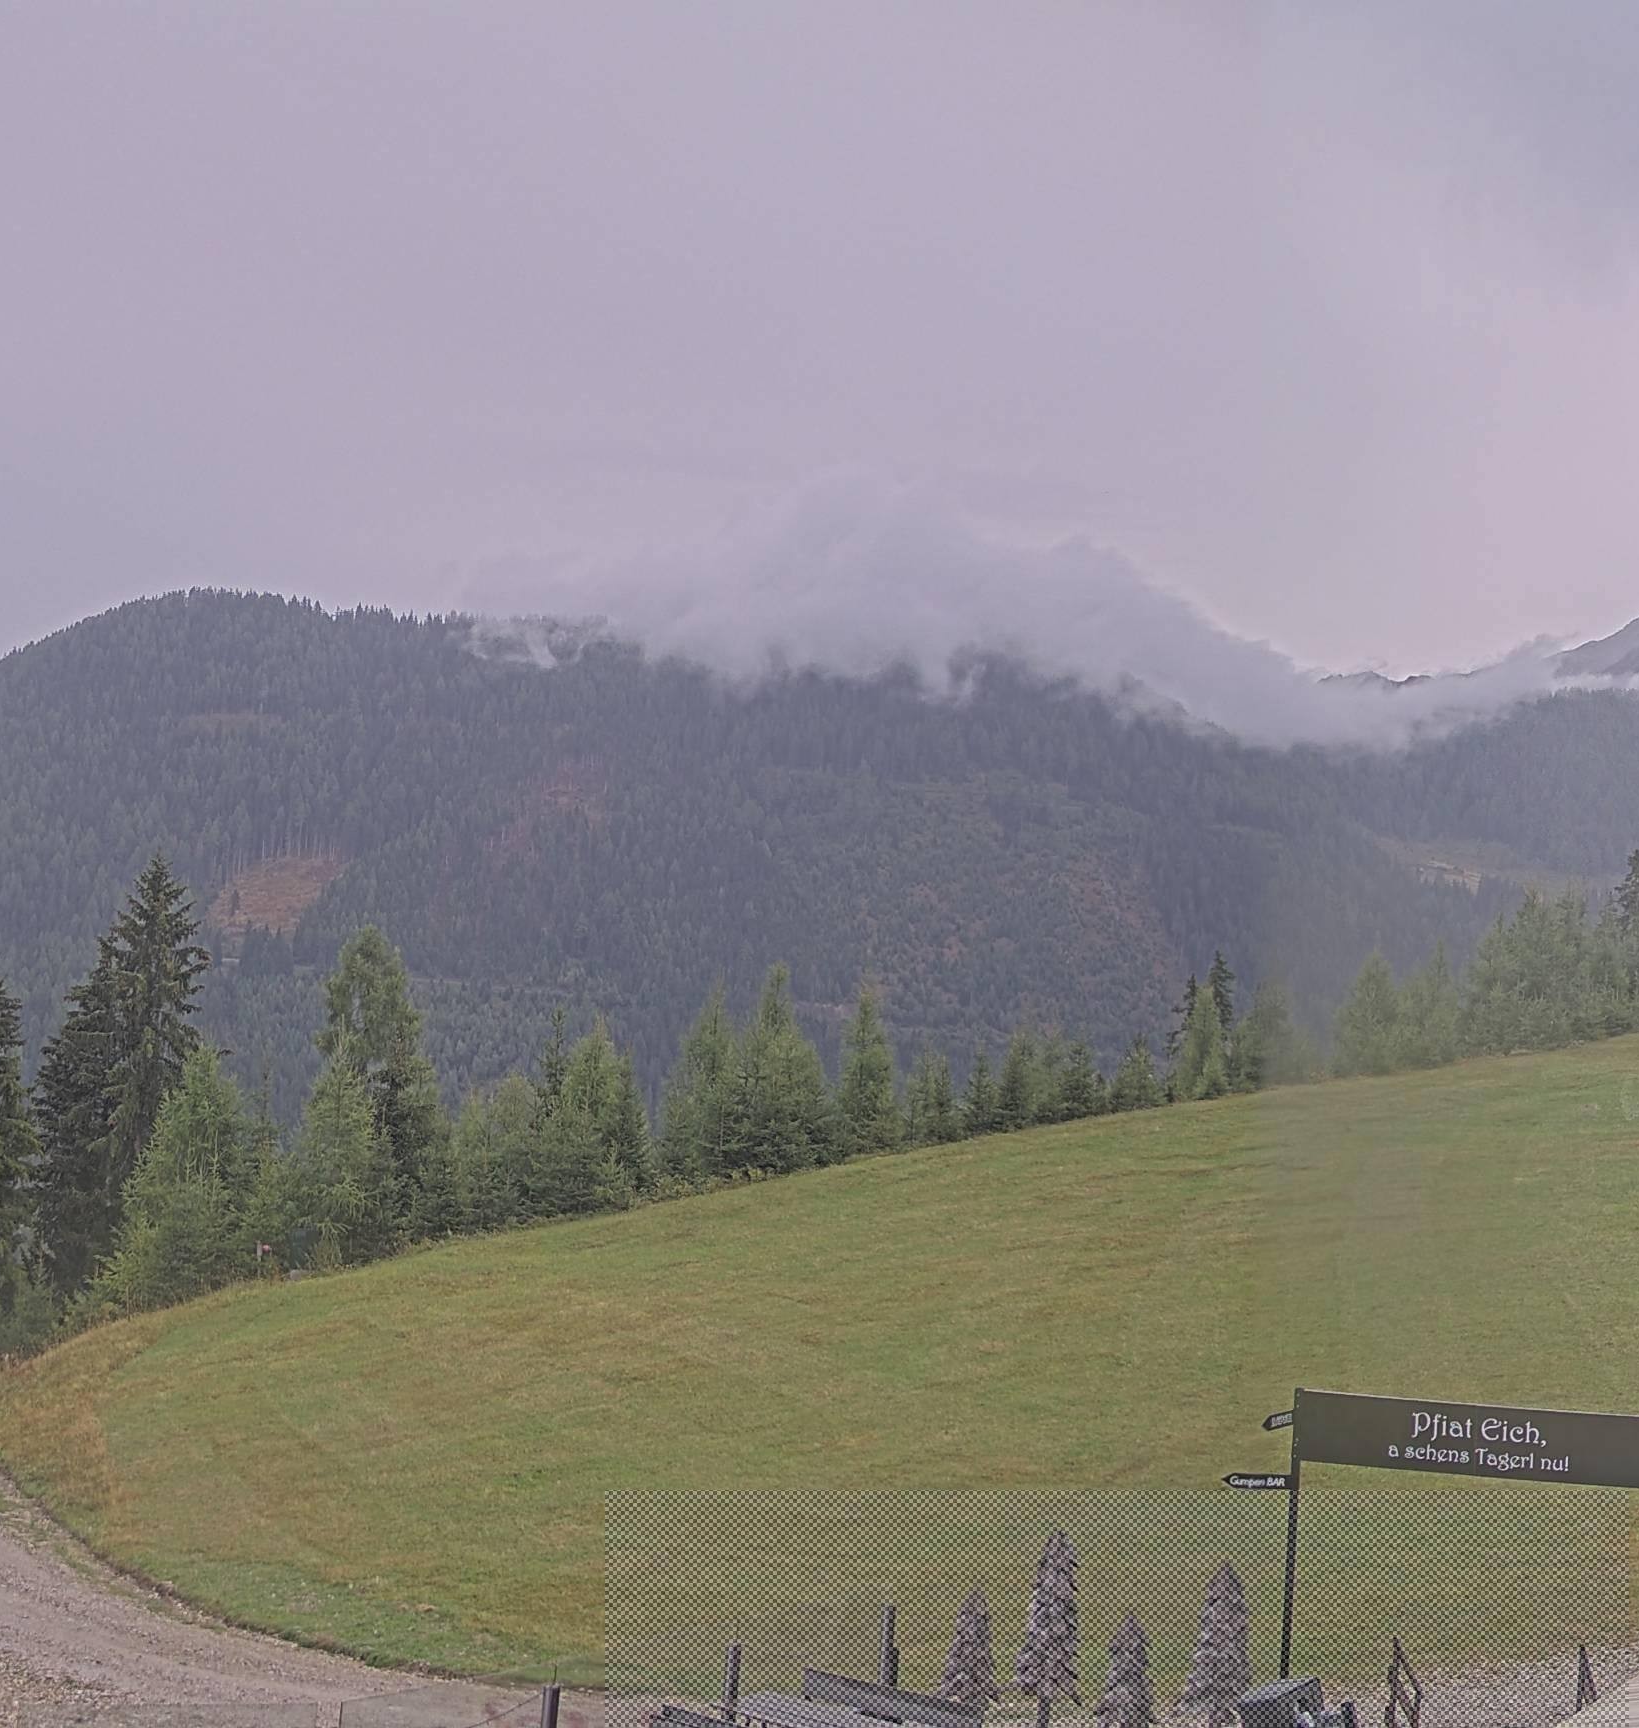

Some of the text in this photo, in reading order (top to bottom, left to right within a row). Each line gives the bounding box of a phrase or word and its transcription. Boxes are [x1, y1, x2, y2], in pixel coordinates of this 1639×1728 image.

[1411, 1412, 1548, 1448] Pfiat Eich,
[1388, 1444, 1399, 1457] a
[1475, 1448, 1534, 1471] Tagerl
[1540, 1456, 1570, 1472] nu!
[1266, 1477, 1285, 1487] BAR
